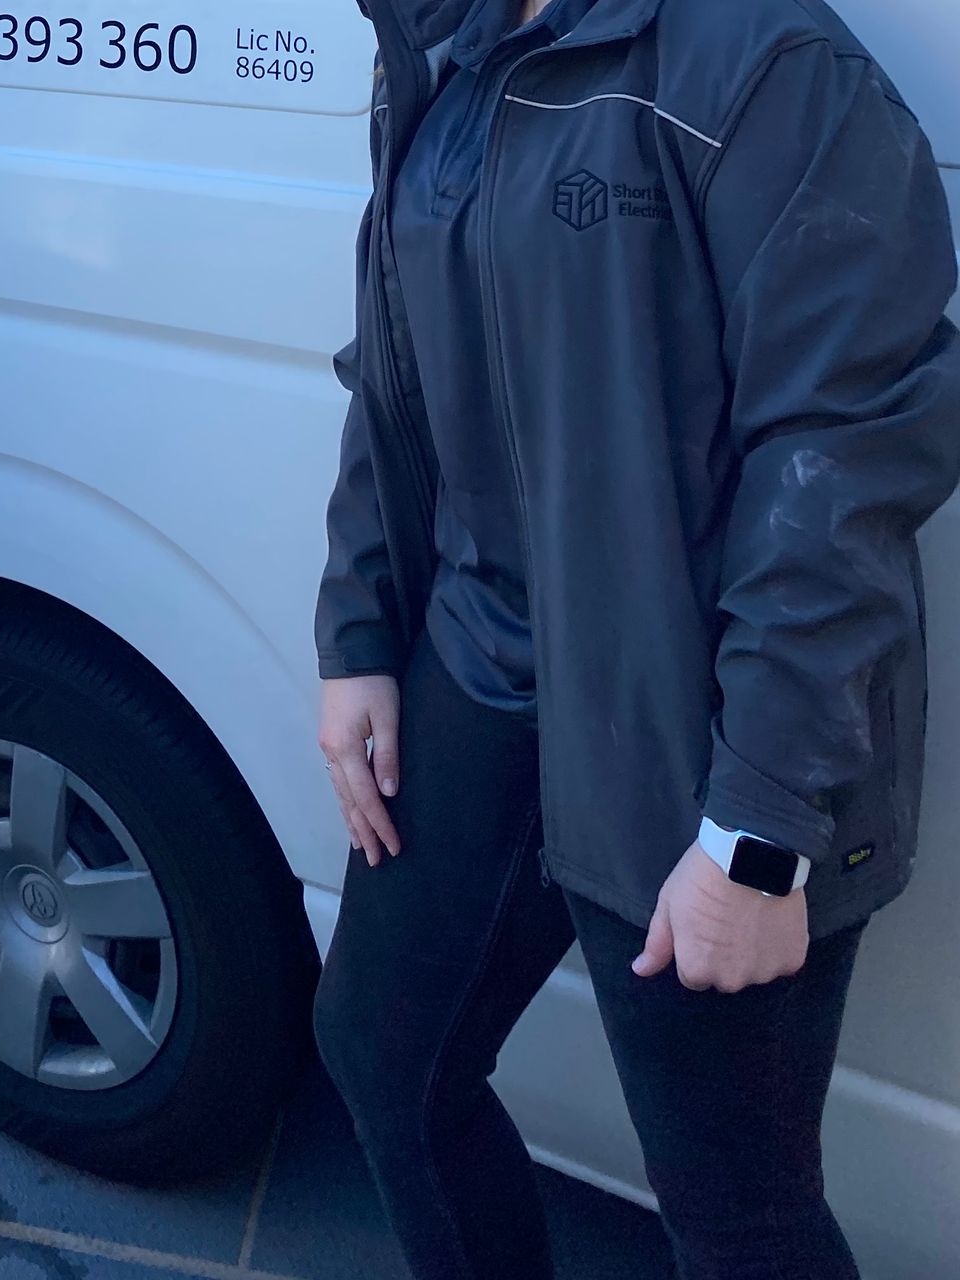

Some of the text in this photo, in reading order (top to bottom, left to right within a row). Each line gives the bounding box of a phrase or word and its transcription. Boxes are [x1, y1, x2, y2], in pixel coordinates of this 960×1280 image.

[99, 20, 198, 75] 360
[236, 27, 316, 55] Lic No.
[235, 56, 315, 83] 86409
[612, 183, 652, 201] Short
